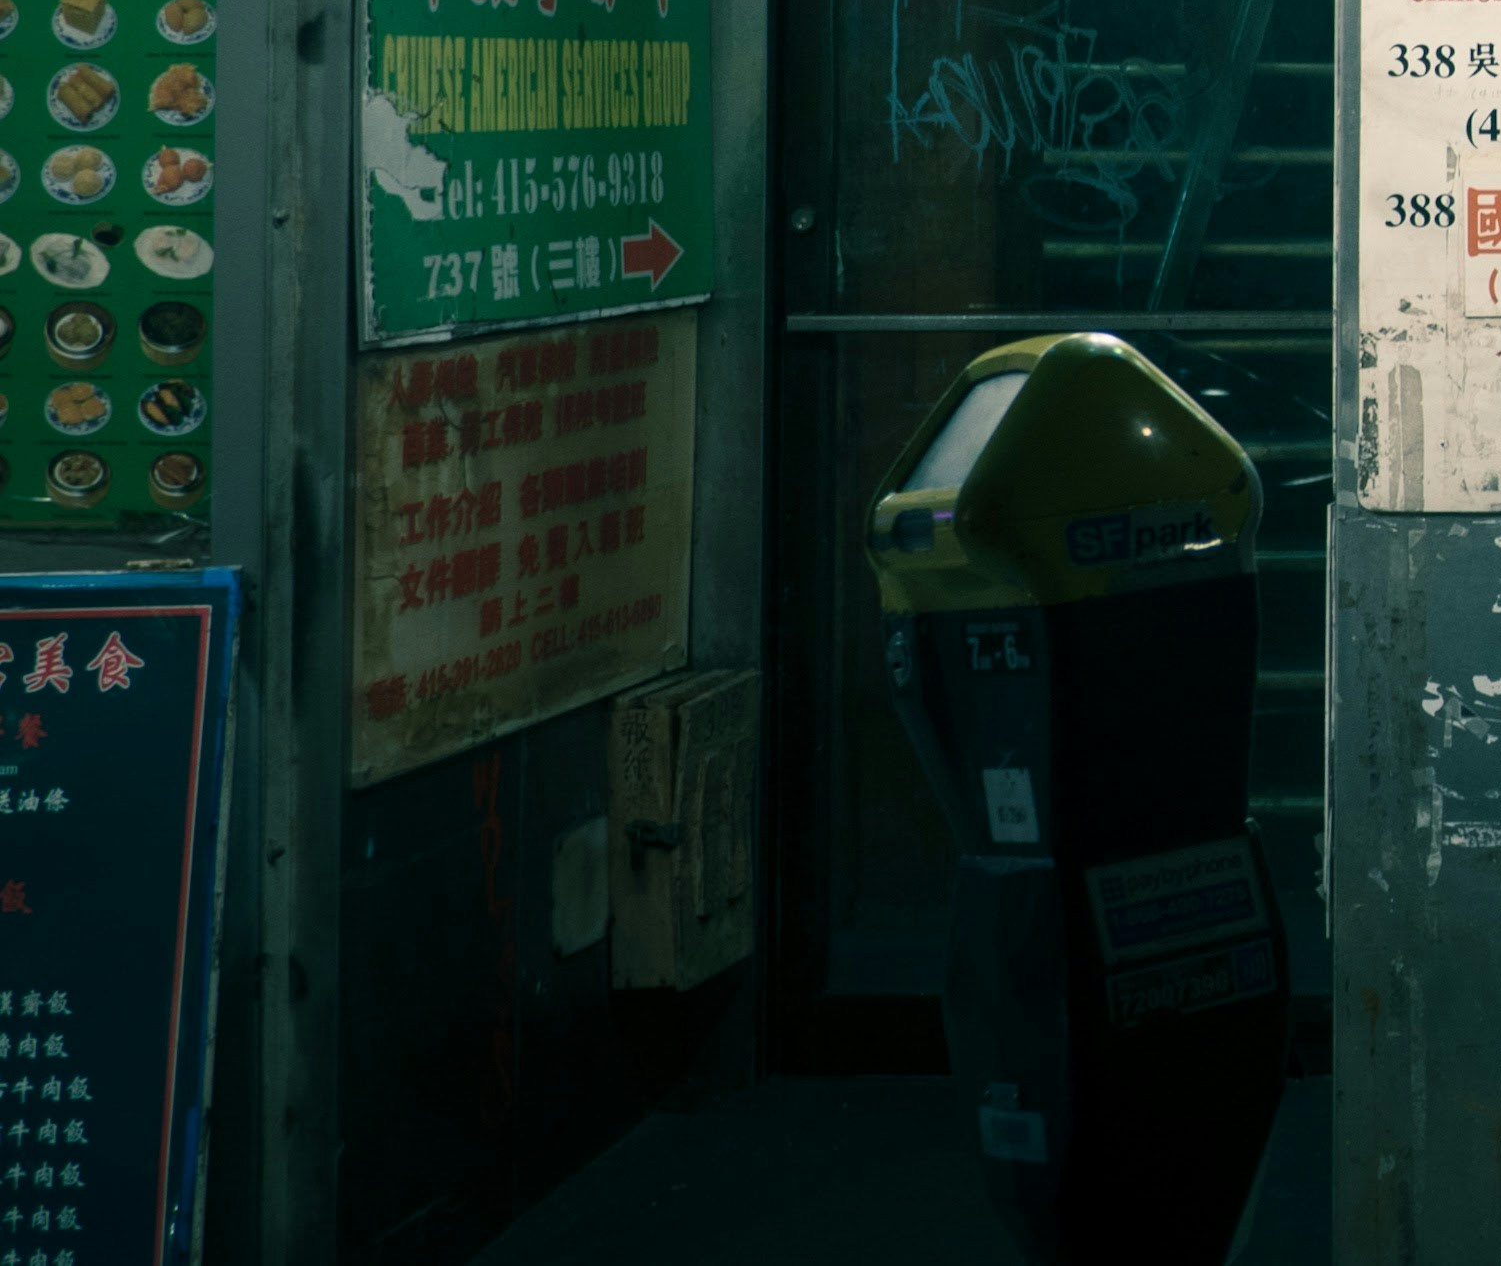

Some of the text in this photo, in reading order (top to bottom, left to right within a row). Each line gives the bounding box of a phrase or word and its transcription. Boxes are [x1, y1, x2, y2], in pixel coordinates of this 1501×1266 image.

[1387, 42, 1458, 80] 338
[382, 33, 691, 135] CHINESE AMERICAN SERVICES GROUP
[446, 150, 665, 221] el: 415-576-9318
[1385, 193, 1456, 229] 388
[422, 250, 484, 301] 737
[399, 480, 502, 547] 工作介紹
[0, 1118, 90, 1148] 牛肉飯
[0, 1161, 86, 1192] 牛肉飯
